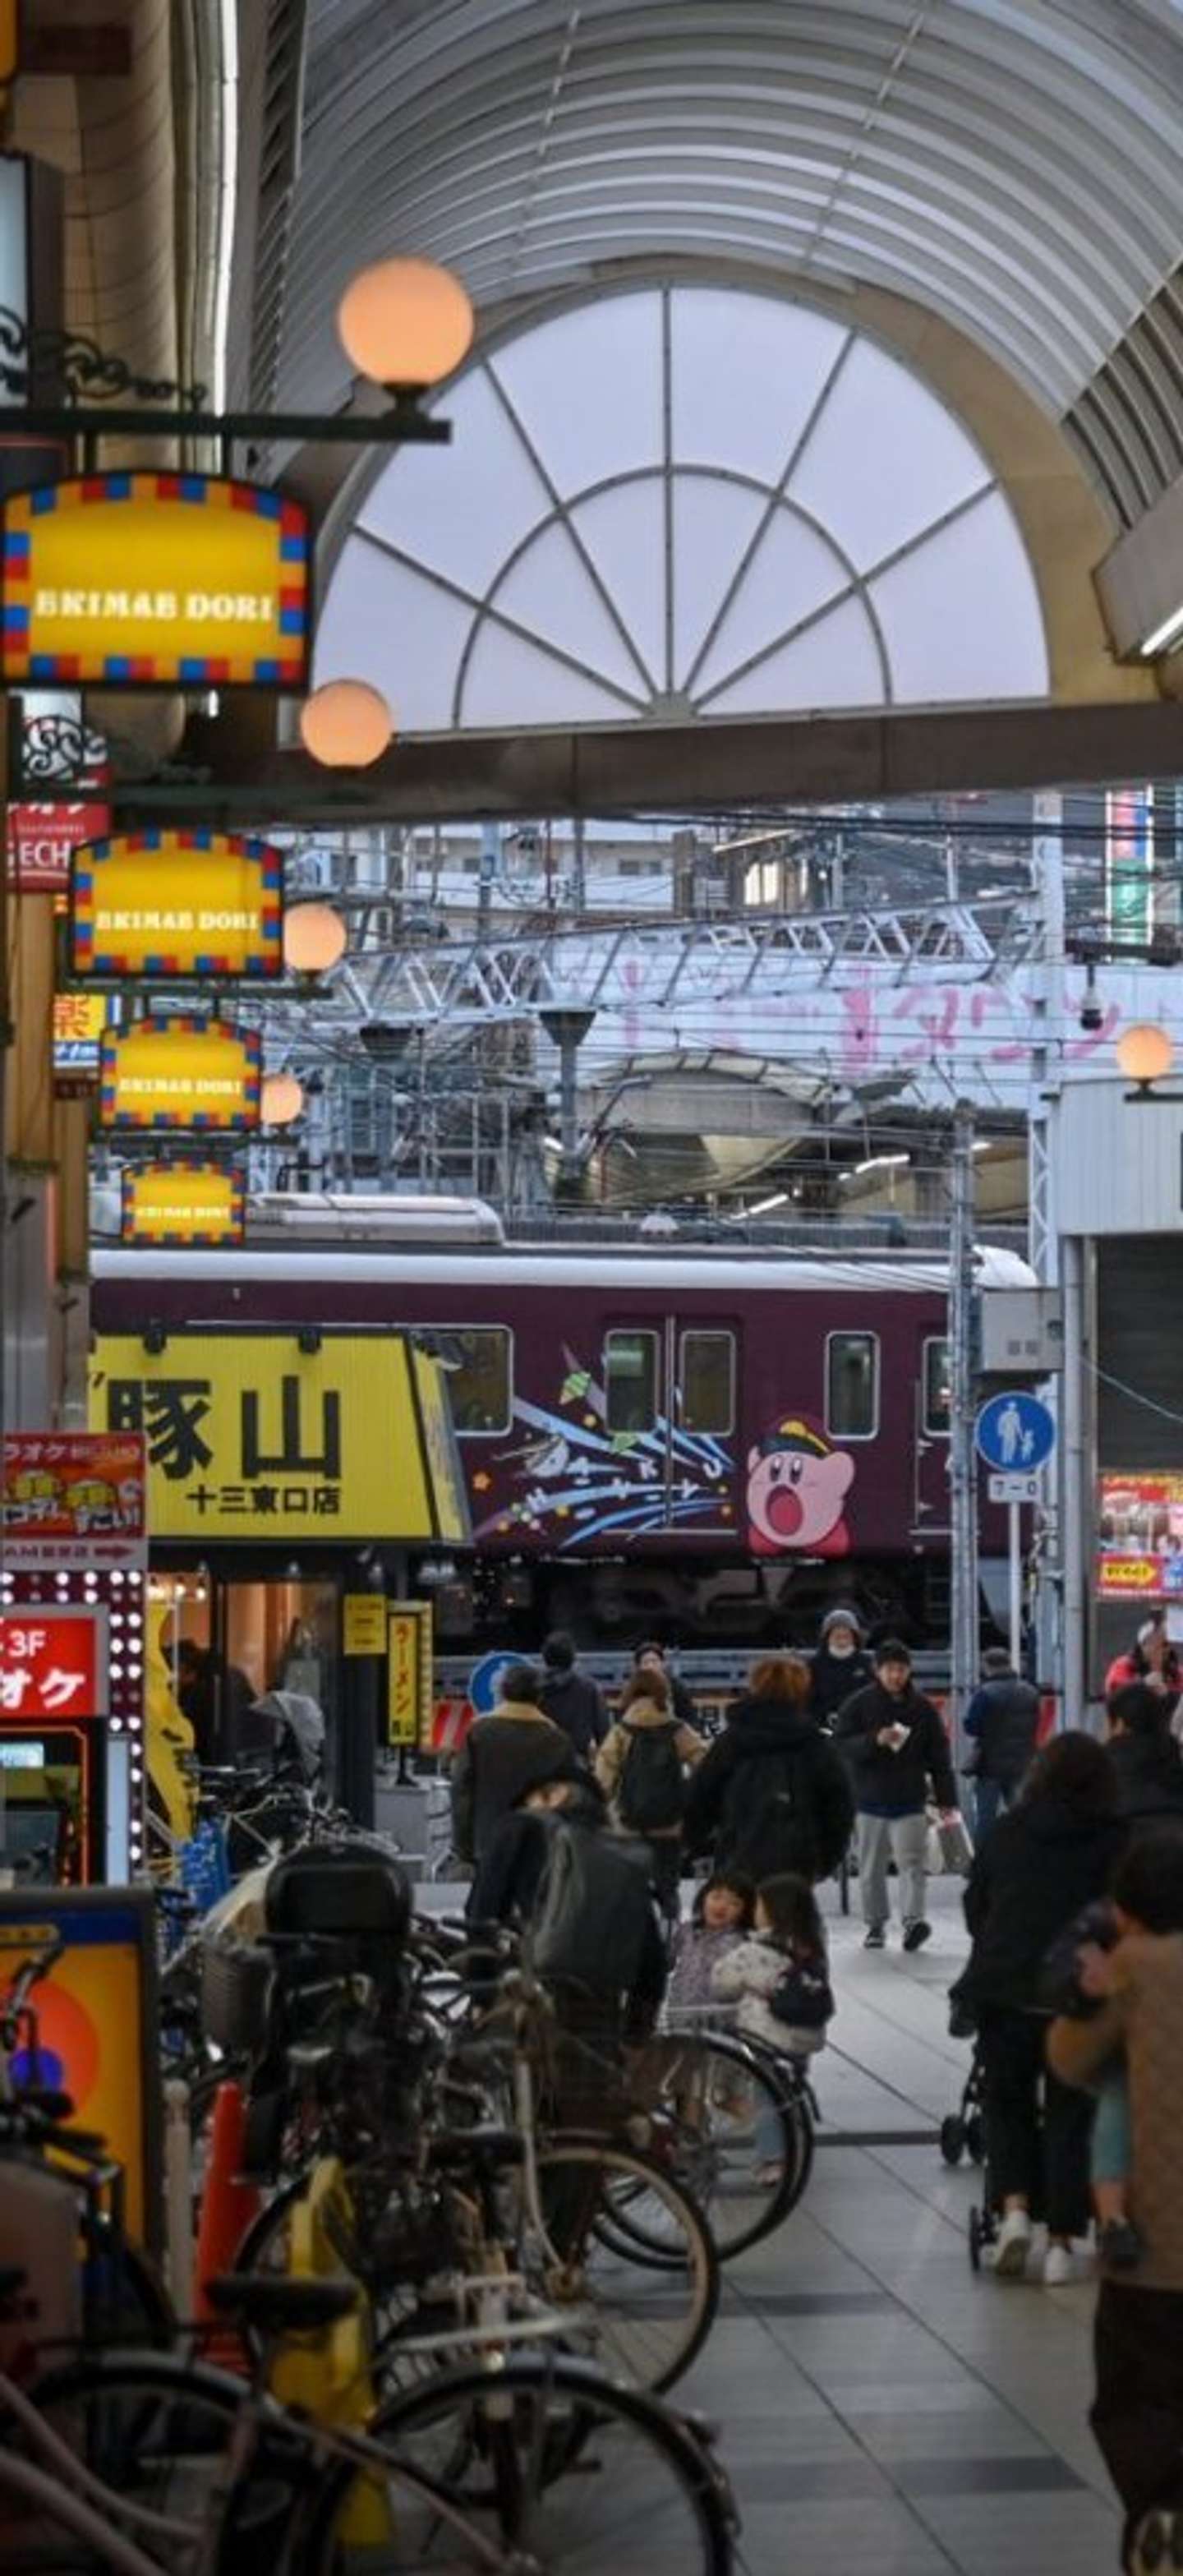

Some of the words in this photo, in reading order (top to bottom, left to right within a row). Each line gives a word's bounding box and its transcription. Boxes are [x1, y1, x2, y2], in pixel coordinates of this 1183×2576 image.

[35, 591, 177, 620] EKIMAE
[186, 593, 273, 622] DORI
[20, 841, 87, 869] ECH
[95, 911, 194, 930] EKIMAE
[199, 912, 259, 930] DORI
[118, 1078, 193, 1094] EKIMAE
[196, 1079, 242, 1094] DORI
[108, 1375, 342, 1481] 豚山
[186, 1485, 342, 1514] 十三東口店
[9, 1630, 46, 1657] 3F
